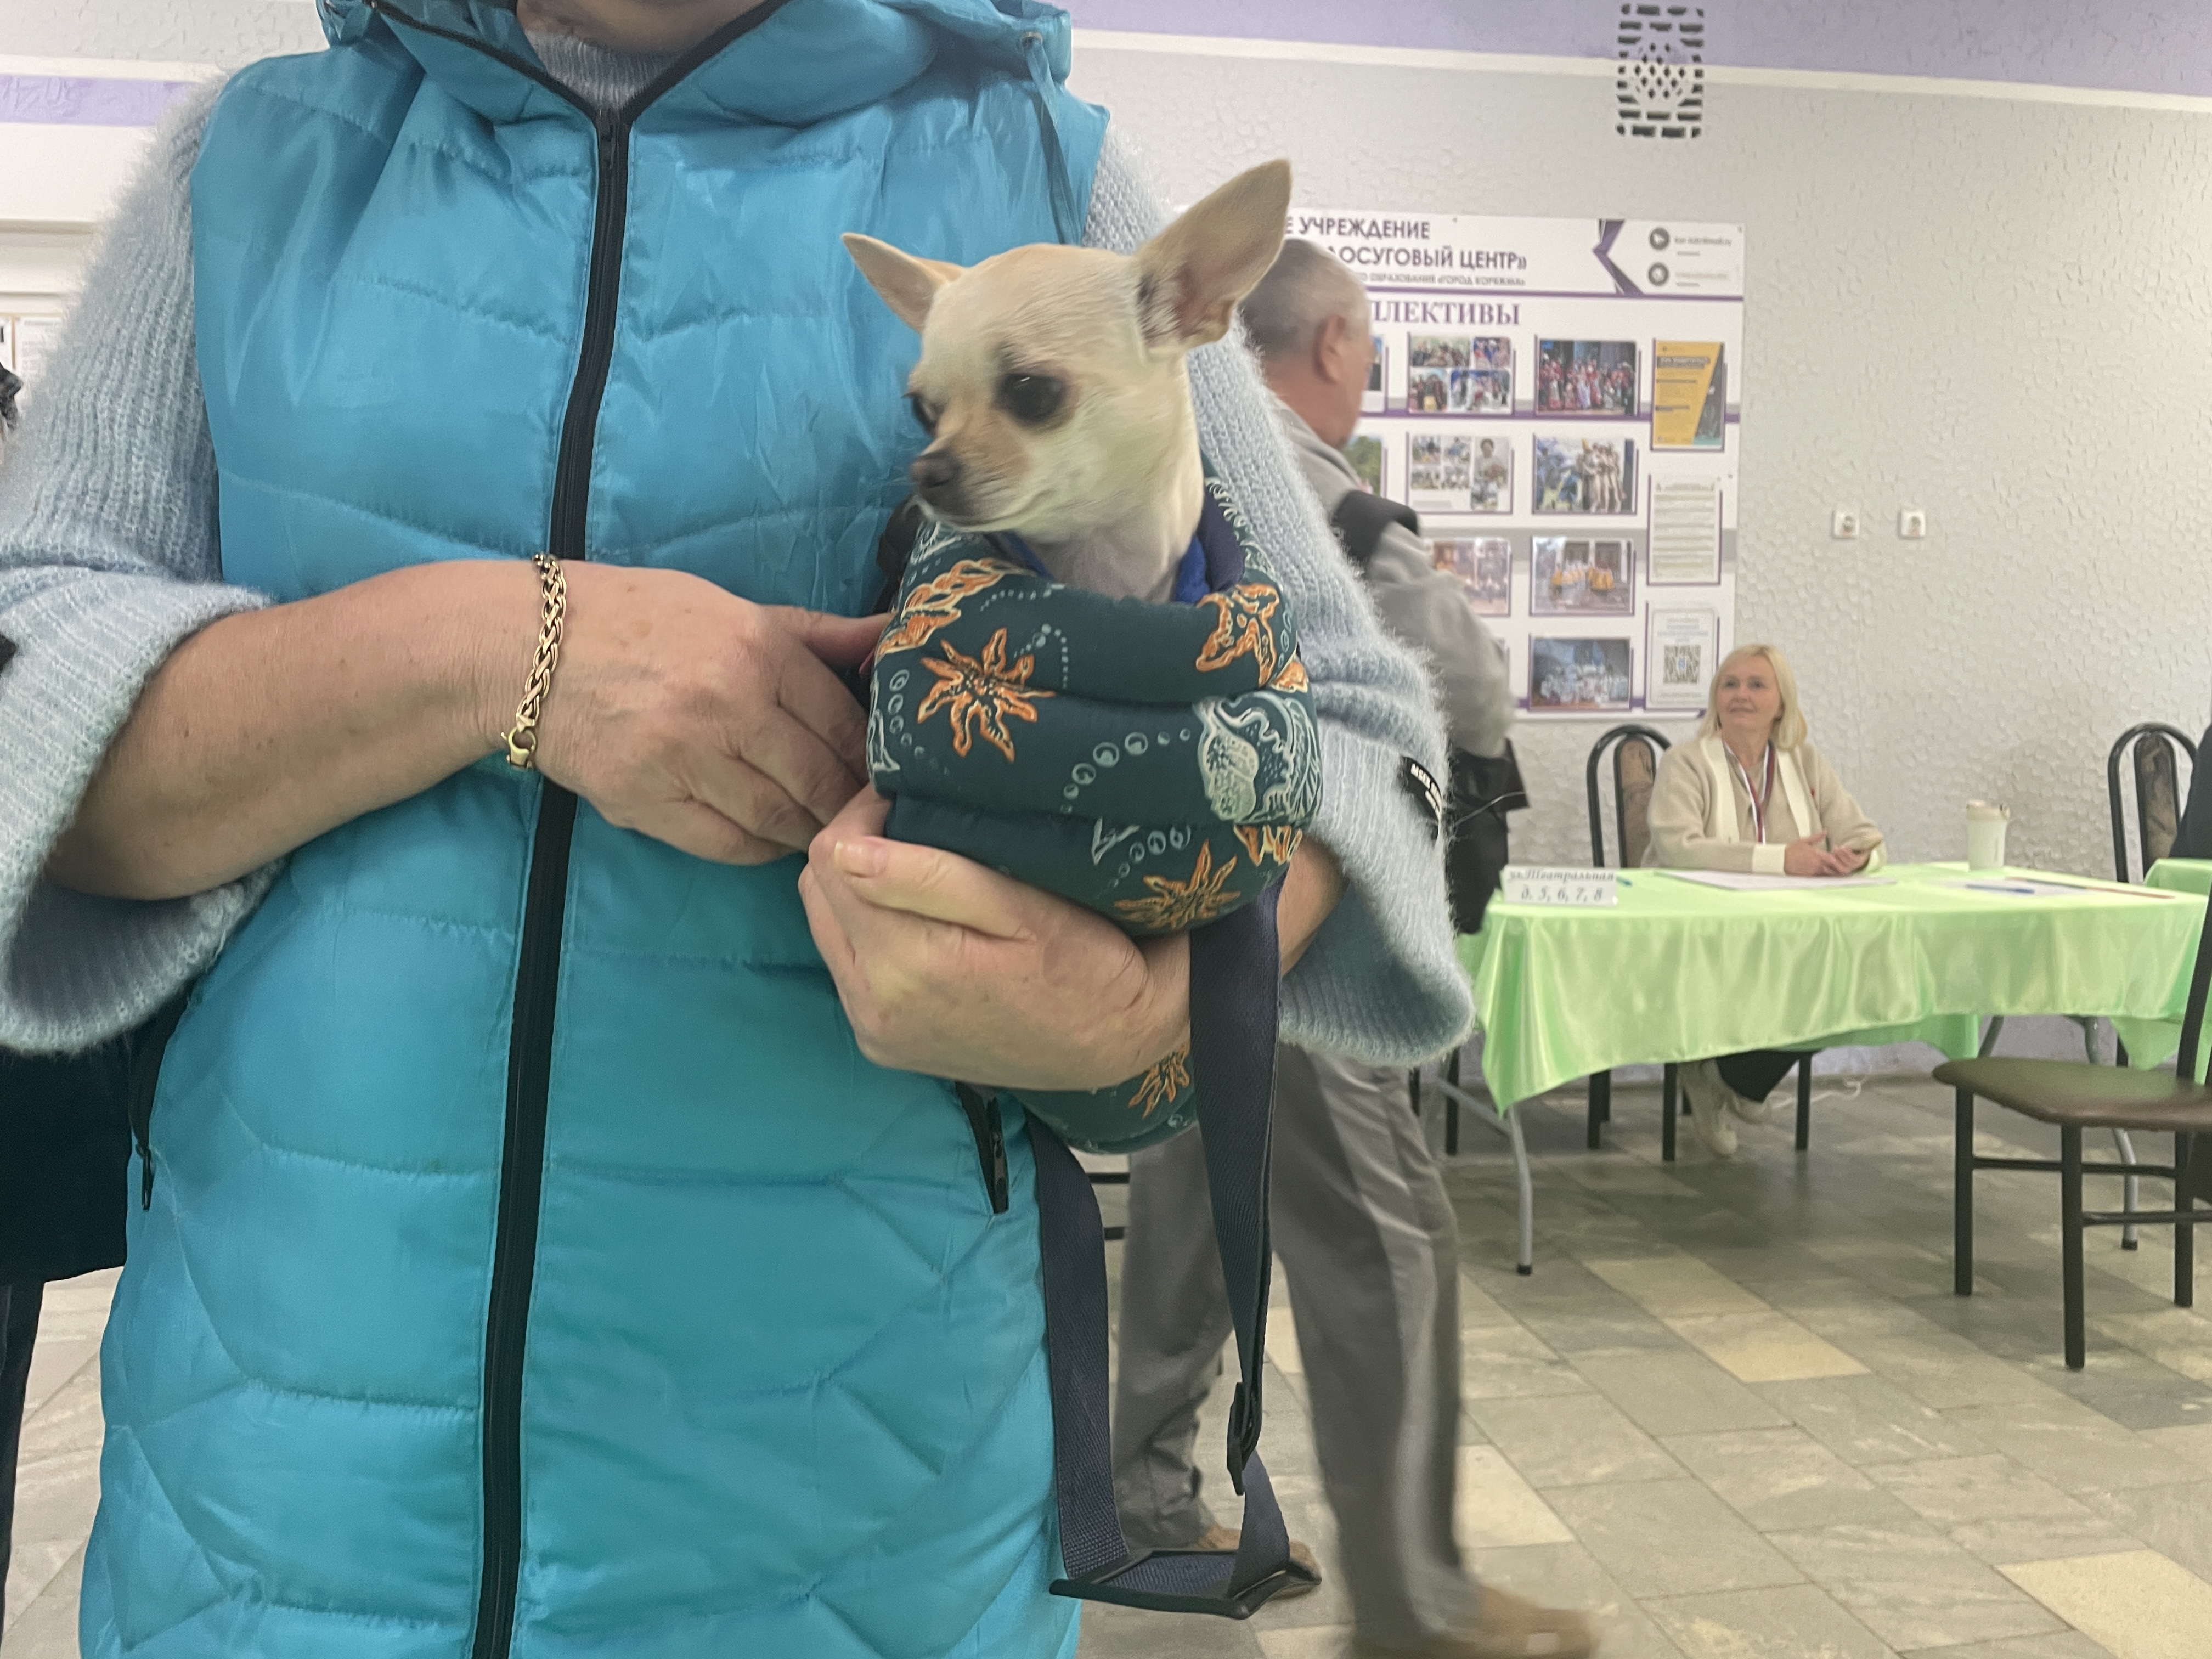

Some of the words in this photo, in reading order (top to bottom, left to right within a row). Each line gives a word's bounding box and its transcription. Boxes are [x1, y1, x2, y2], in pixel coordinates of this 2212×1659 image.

[1299, 216, 1430, 239] УЧРЕЖДЕНИЕ
[1328, 245, 1453, 268] ОСУГОВЫЙ
[1459, 250, 1527, 270] ЦЕНТР»
